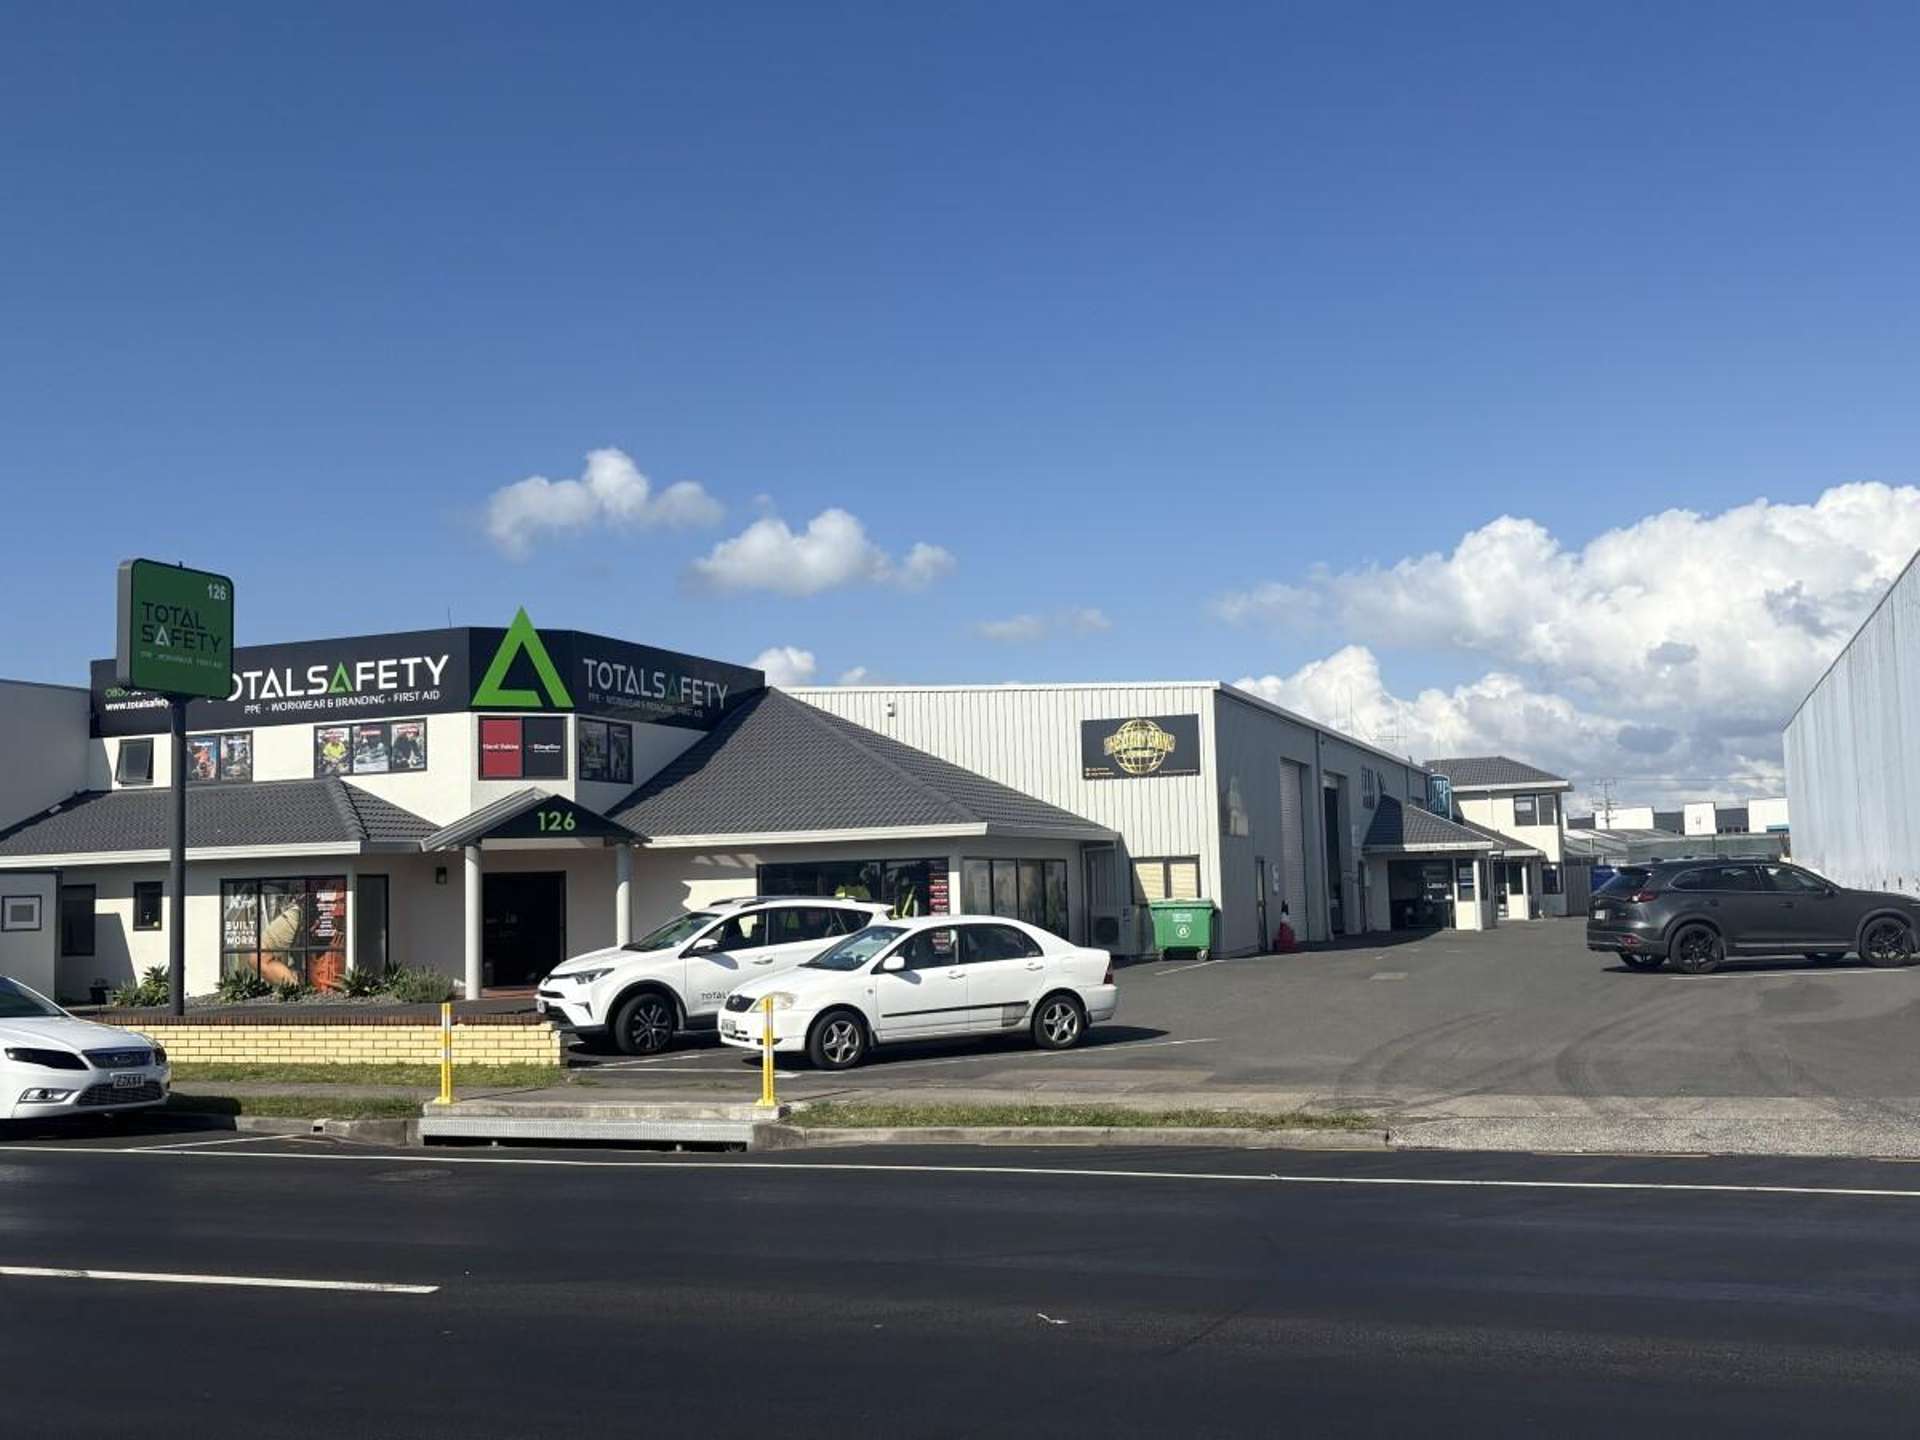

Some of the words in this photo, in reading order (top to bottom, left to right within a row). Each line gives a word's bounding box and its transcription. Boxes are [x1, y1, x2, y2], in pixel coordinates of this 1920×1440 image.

[207, 583, 226, 600] 126
[142, 601, 206, 630] TOTAL
[142, 624, 222, 653] SAFETY
[583, 658, 728, 710] TOTALSAFETY
[244, 704, 261, 714] PPE
[271, 698, 325, 712] WORKWEAR
[335, 694, 385, 708] BRANDING
[393, 690, 420, 702] FIRST
[422, 690, 440, 700] AID
[537, 811, 576, 831] 126
